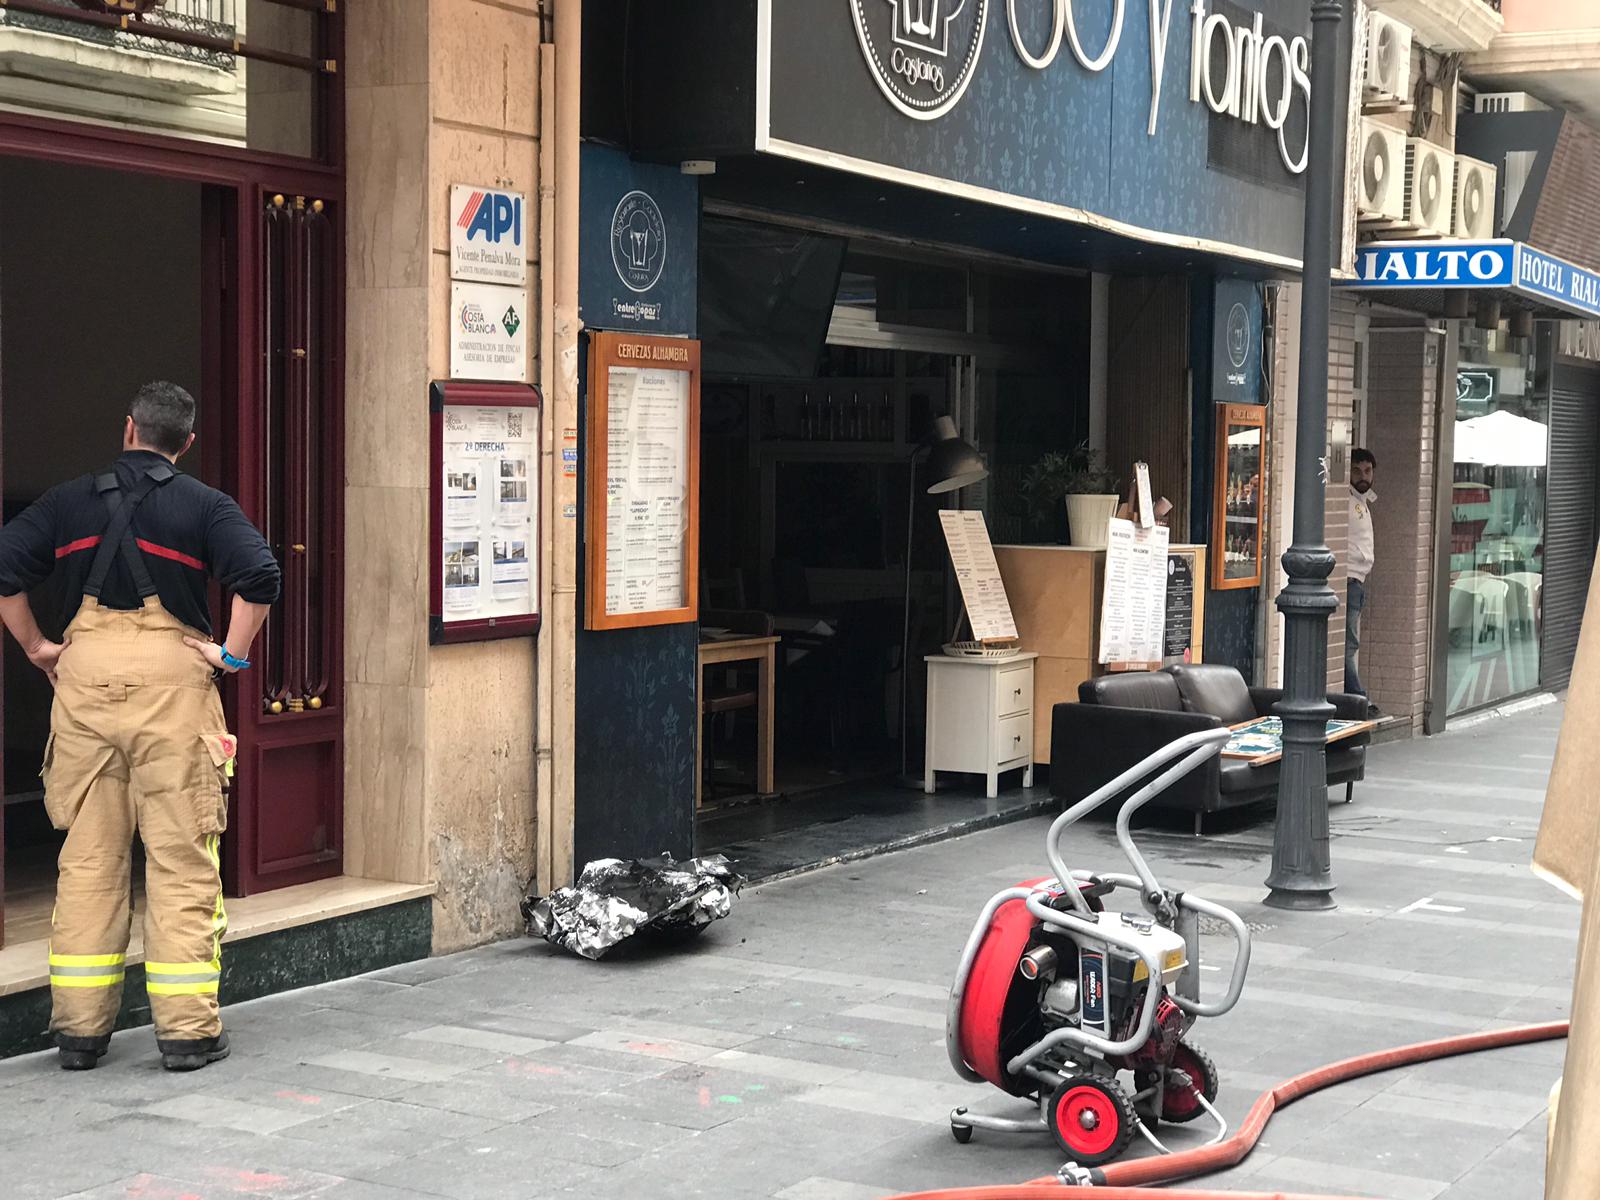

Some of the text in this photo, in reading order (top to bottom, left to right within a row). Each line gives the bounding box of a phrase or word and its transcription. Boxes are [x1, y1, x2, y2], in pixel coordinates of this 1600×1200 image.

[467, 192, 521, 246] API
[456, 245, 480, 261] Vicente
[505, 251, 521, 266] Mora
[1520, 252, 1600, 308] HOTEL RIAL
[467, 323, 496, 334] BLANCA
[497, 344, 505, 353] DE
[618, 343, 689, 362] CERVEZAS ALHAMBRA
[474, 442, 505, 452] DERECHA
